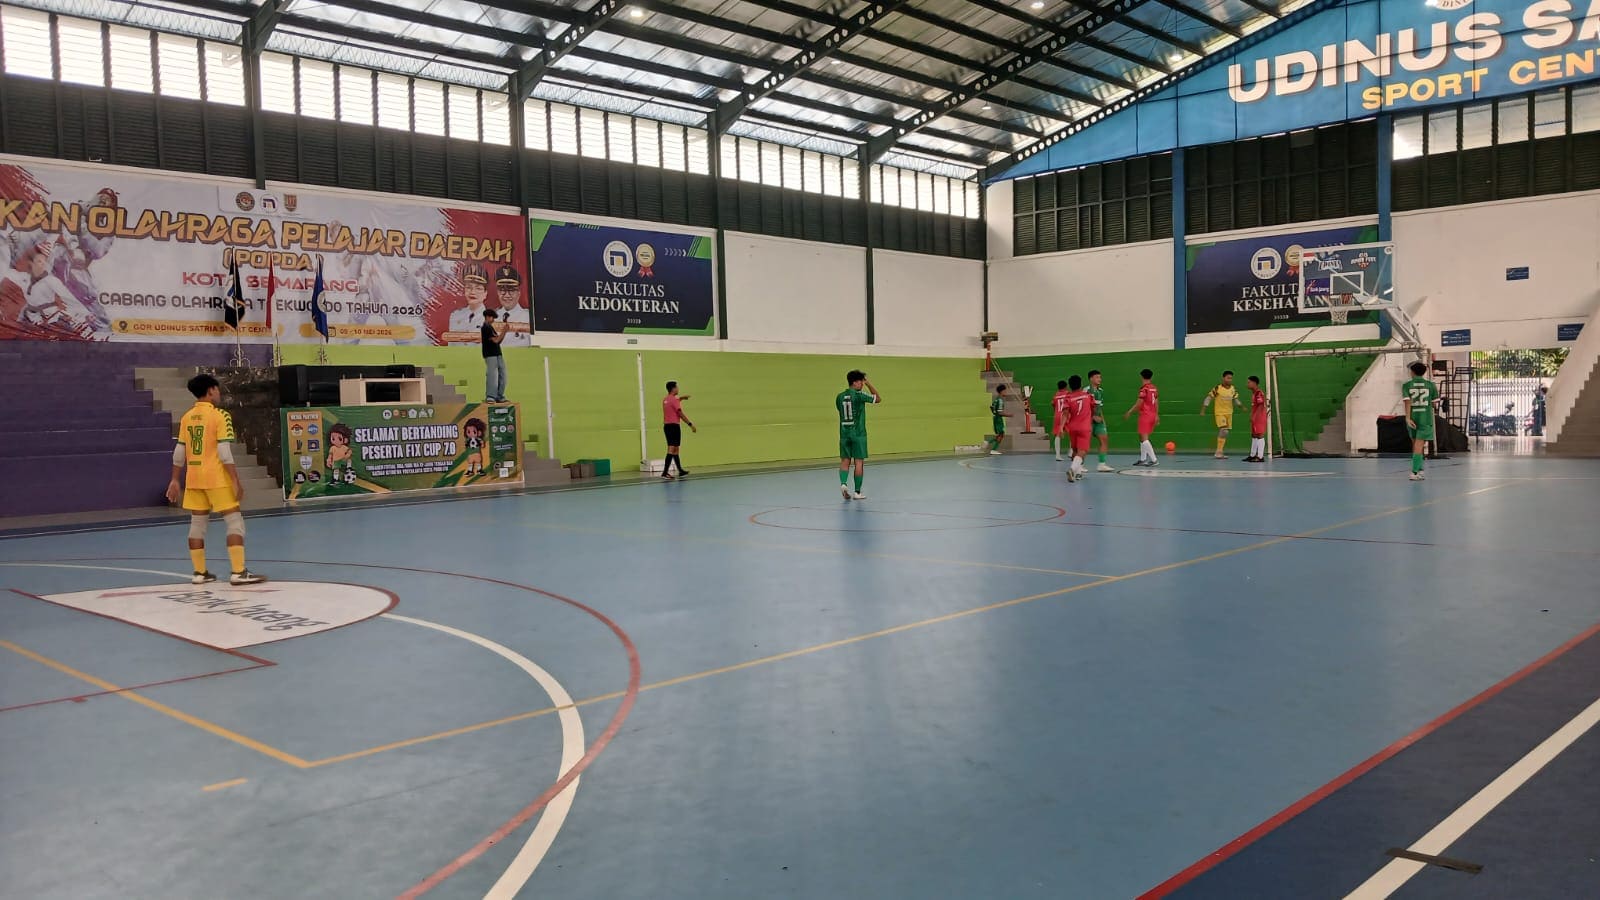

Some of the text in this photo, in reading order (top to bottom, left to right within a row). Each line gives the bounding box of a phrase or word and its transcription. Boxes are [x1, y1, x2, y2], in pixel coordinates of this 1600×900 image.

[1228, 12, 1503, 103] UDINUS
[1361, 68, 1489, 110] SPORT
[88, 205, 277, 248] OLAHRAGA
[281, 220, 406, 258] PELAJAR
[410, 231, 514, 264] DAERAH
[182, 272, 234, 287] KOT
[594, 281, 665, 298] FAKULTAS
[1241, 283, 1299, 299] FAKULT
[100, 292, 423, 317] CABANG OLAHRA TEKWODO TAHUN 2026
[577, 296, 680, 314] KEDOKTERAN
[133, 323, 152, 331] GOR
[154, 323, 187, 332] UDINUS
[1408, 388, 1430, 407] 22
[842, 401, 853, 420] 11
[1076, 399, 1083, 416] 7
[187, 425, 205, 456] 18
[355, 425, 459, 443] SELAMAT BERTANDING
[362, 444, 403, 460] PESERTA
[405, 443, 421, 458] FIX
[423, 442, 442, 457] CUP
